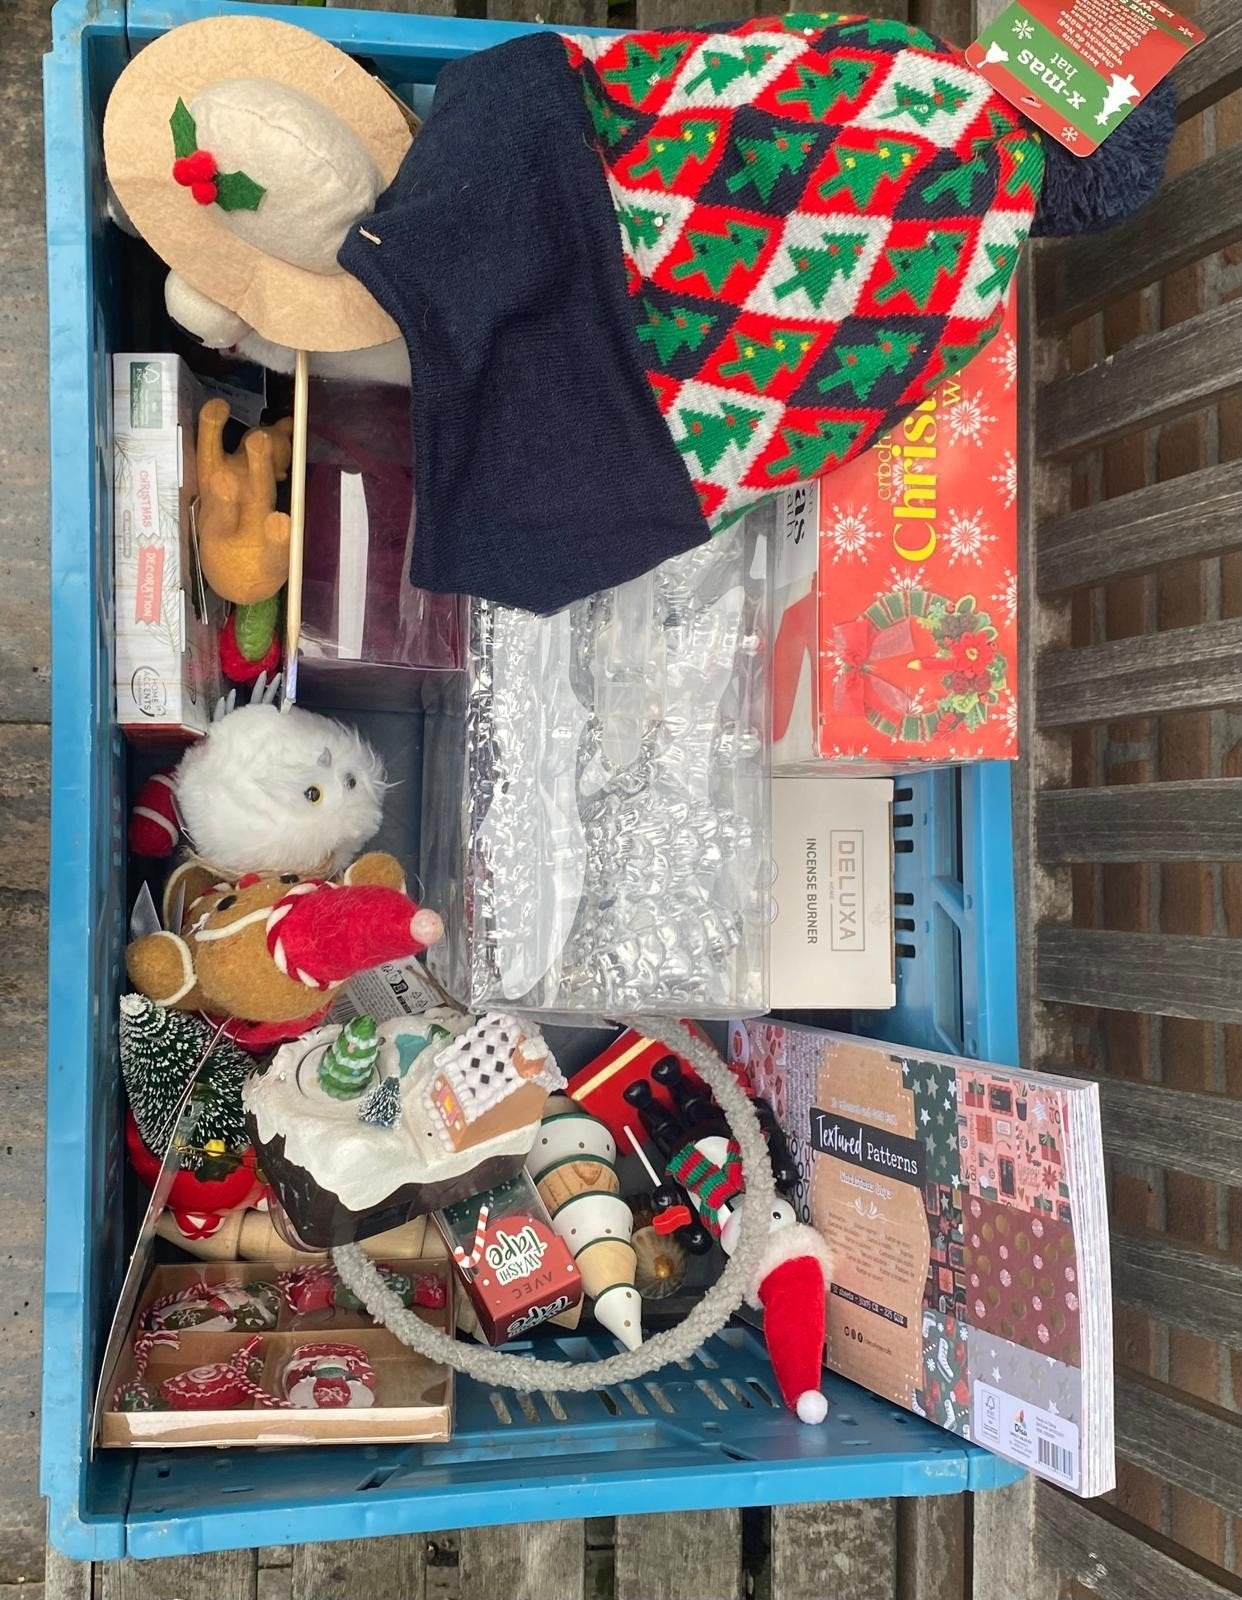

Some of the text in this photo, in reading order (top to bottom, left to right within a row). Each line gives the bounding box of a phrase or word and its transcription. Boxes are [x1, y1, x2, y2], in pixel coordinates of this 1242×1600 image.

[1128, 1, 1156, 22] ONE
[1049, 52, 1078, 81] hat
[1085, 41, 1115, 69] chapeau
[1017, 48, 1087, 110] x-mas
[137, 469, 153, 529] CHRISTMAS
[141, 551, 157, 618] DECORATION
[143, 669, 153, 712] ACCENTS
[151, 676, 160, 704] HOME
[806, 837, 818, 945] INCENSE BURNER
[837, 840, 858, 941] DELUXA
[815, 1114, 918, 1175] Textured Patterns
[488, 1228, 547, 1267] tape
[499, 1252, 539, 1283] WASHI
[511, 1271, 553, 1299] AVEC
